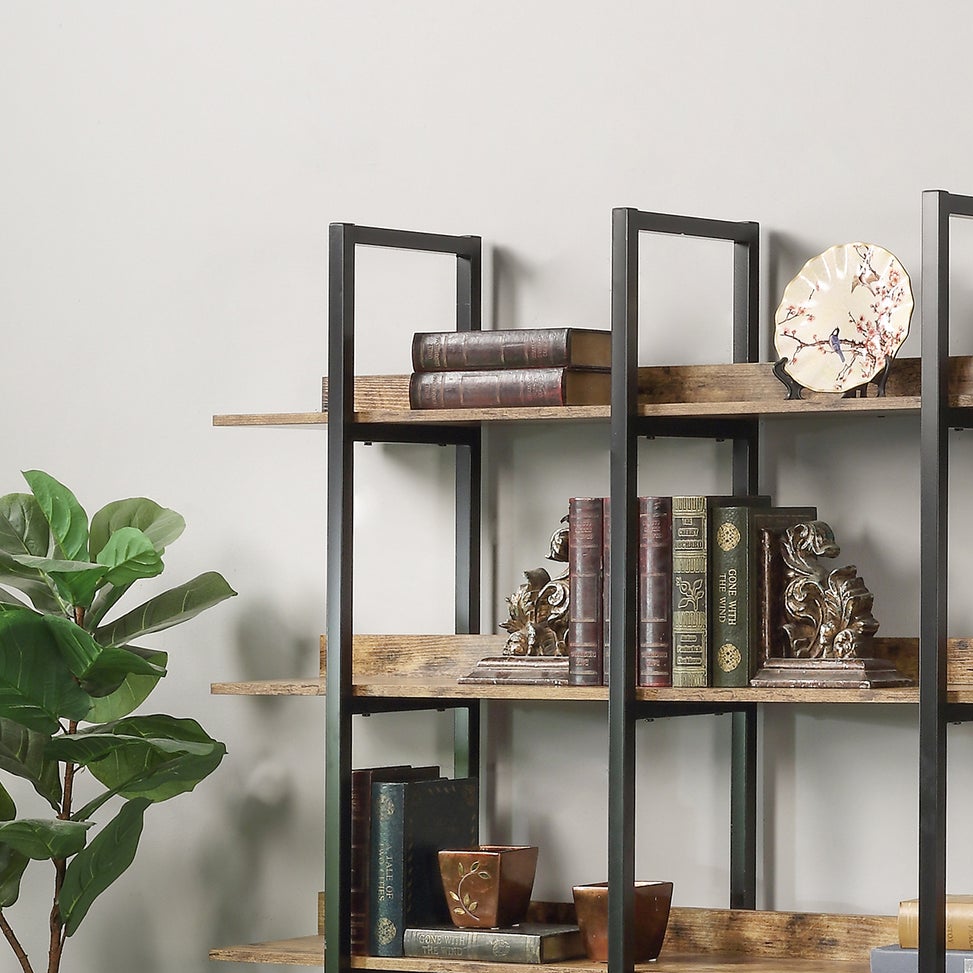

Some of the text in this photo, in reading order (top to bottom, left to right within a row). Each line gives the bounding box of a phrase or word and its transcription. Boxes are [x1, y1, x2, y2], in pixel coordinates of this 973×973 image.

[719, 574, 727, 623] THE WIND
[727, 568, 737, 626] GONE WITH
[386, 884, 394, 901] OF
[418, 934, 466, 946] GONE WITH
[422, 944, 439, 955] THE
